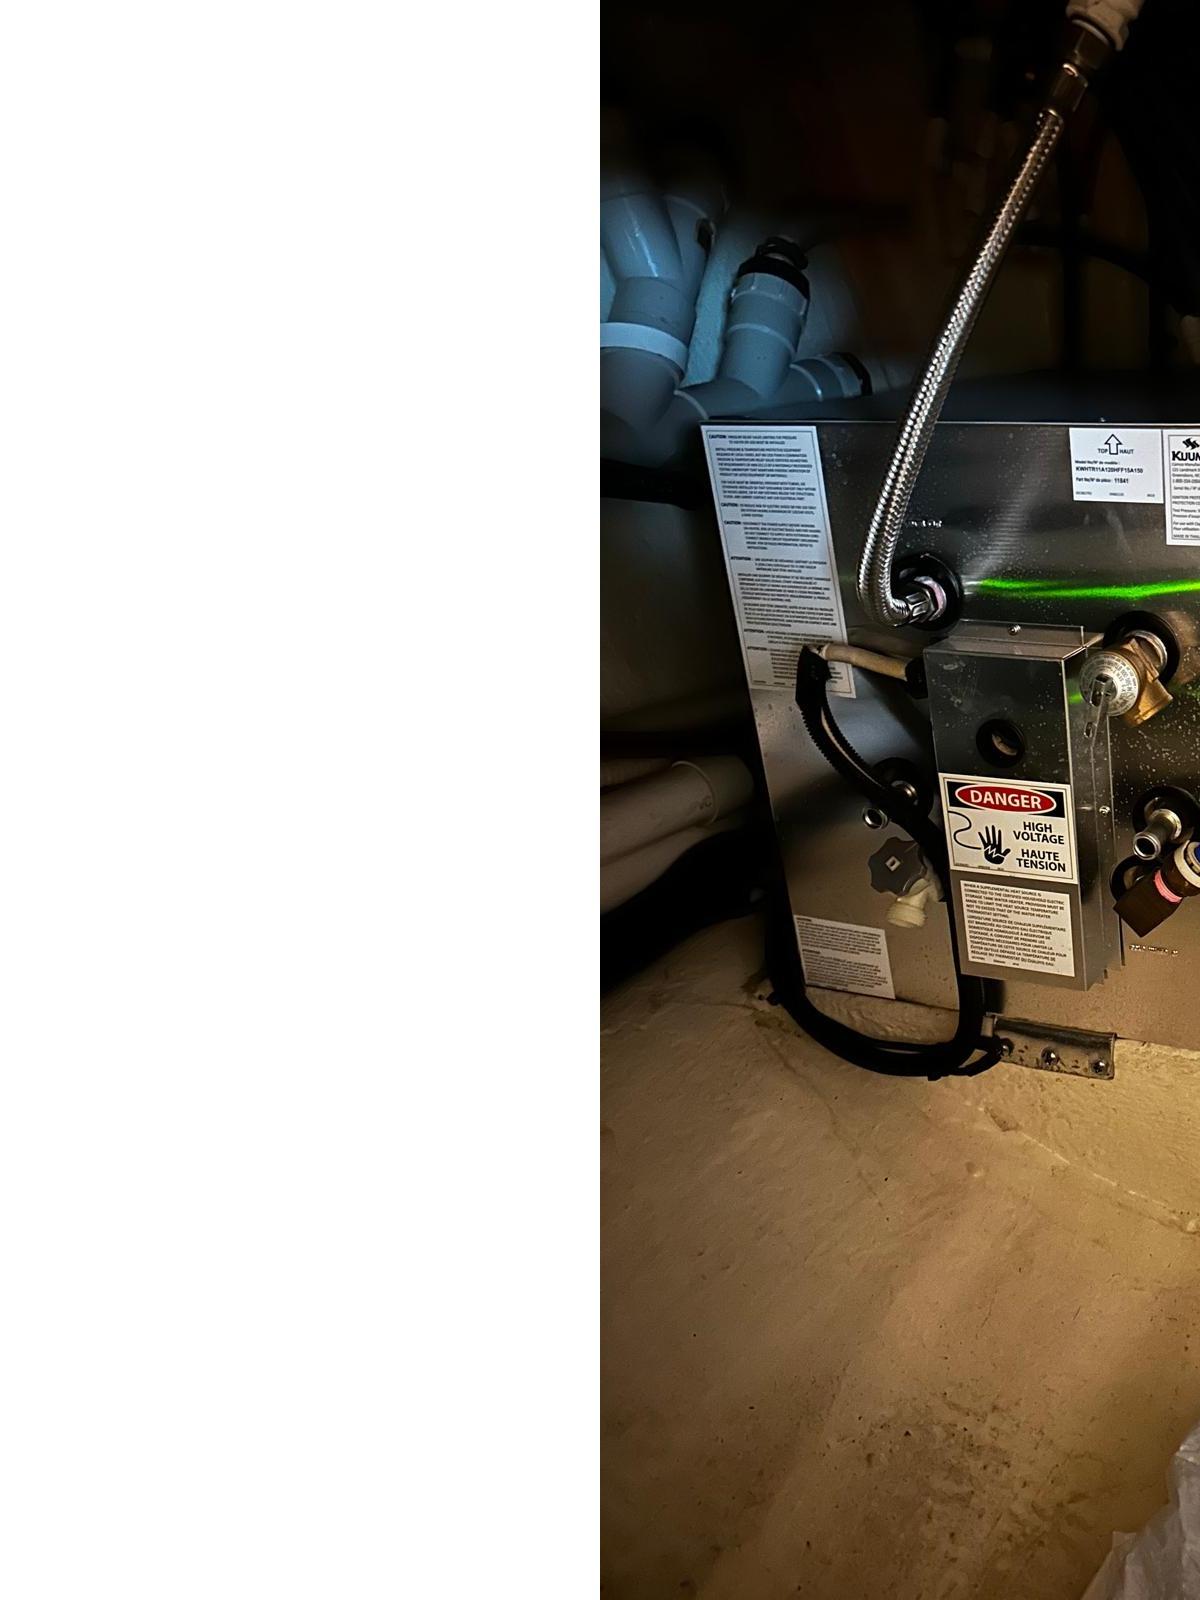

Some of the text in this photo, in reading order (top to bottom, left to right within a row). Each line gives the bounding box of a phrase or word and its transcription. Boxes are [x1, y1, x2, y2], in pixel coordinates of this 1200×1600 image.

[970, 790, 1042, 810] DANGER
[1023, 821, 1052, 833] HIGH
[1013, 830, 1064, 844] VOLTAGE
[1021, 849, 1059, 861] HAUTE
[1016, 858, 1066, 872] TENSION
